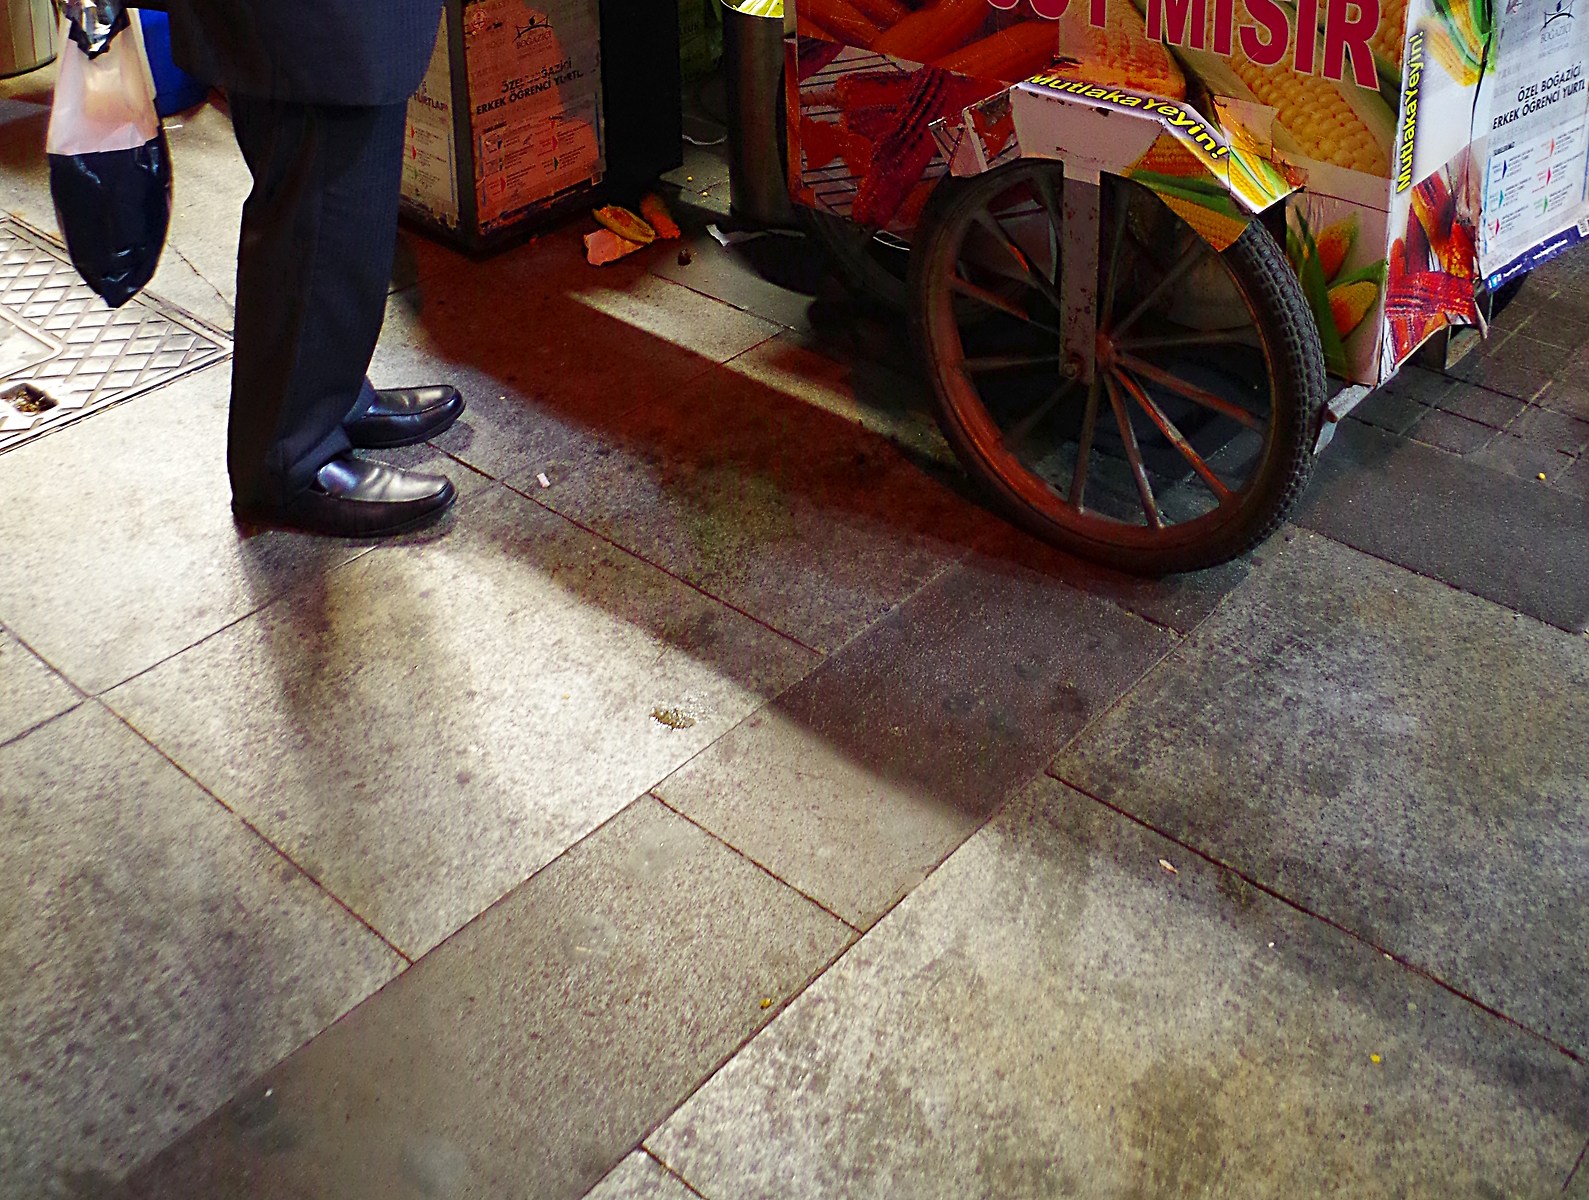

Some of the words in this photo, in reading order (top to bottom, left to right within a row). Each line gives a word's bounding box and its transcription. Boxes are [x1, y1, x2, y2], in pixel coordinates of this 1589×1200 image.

[476, 97, 506, 116] ERKEK
[509, 79, 552, 103] ÖĞRENCİ
[1517, 84, 1539, 102] ÖZEL
[1541, 60, 1582, 92] BOĞAZİÇİ
[1492, 106, 1520, 130] ERKEK
[1522, 85, 1561, 117] ÖĞRENCİ
